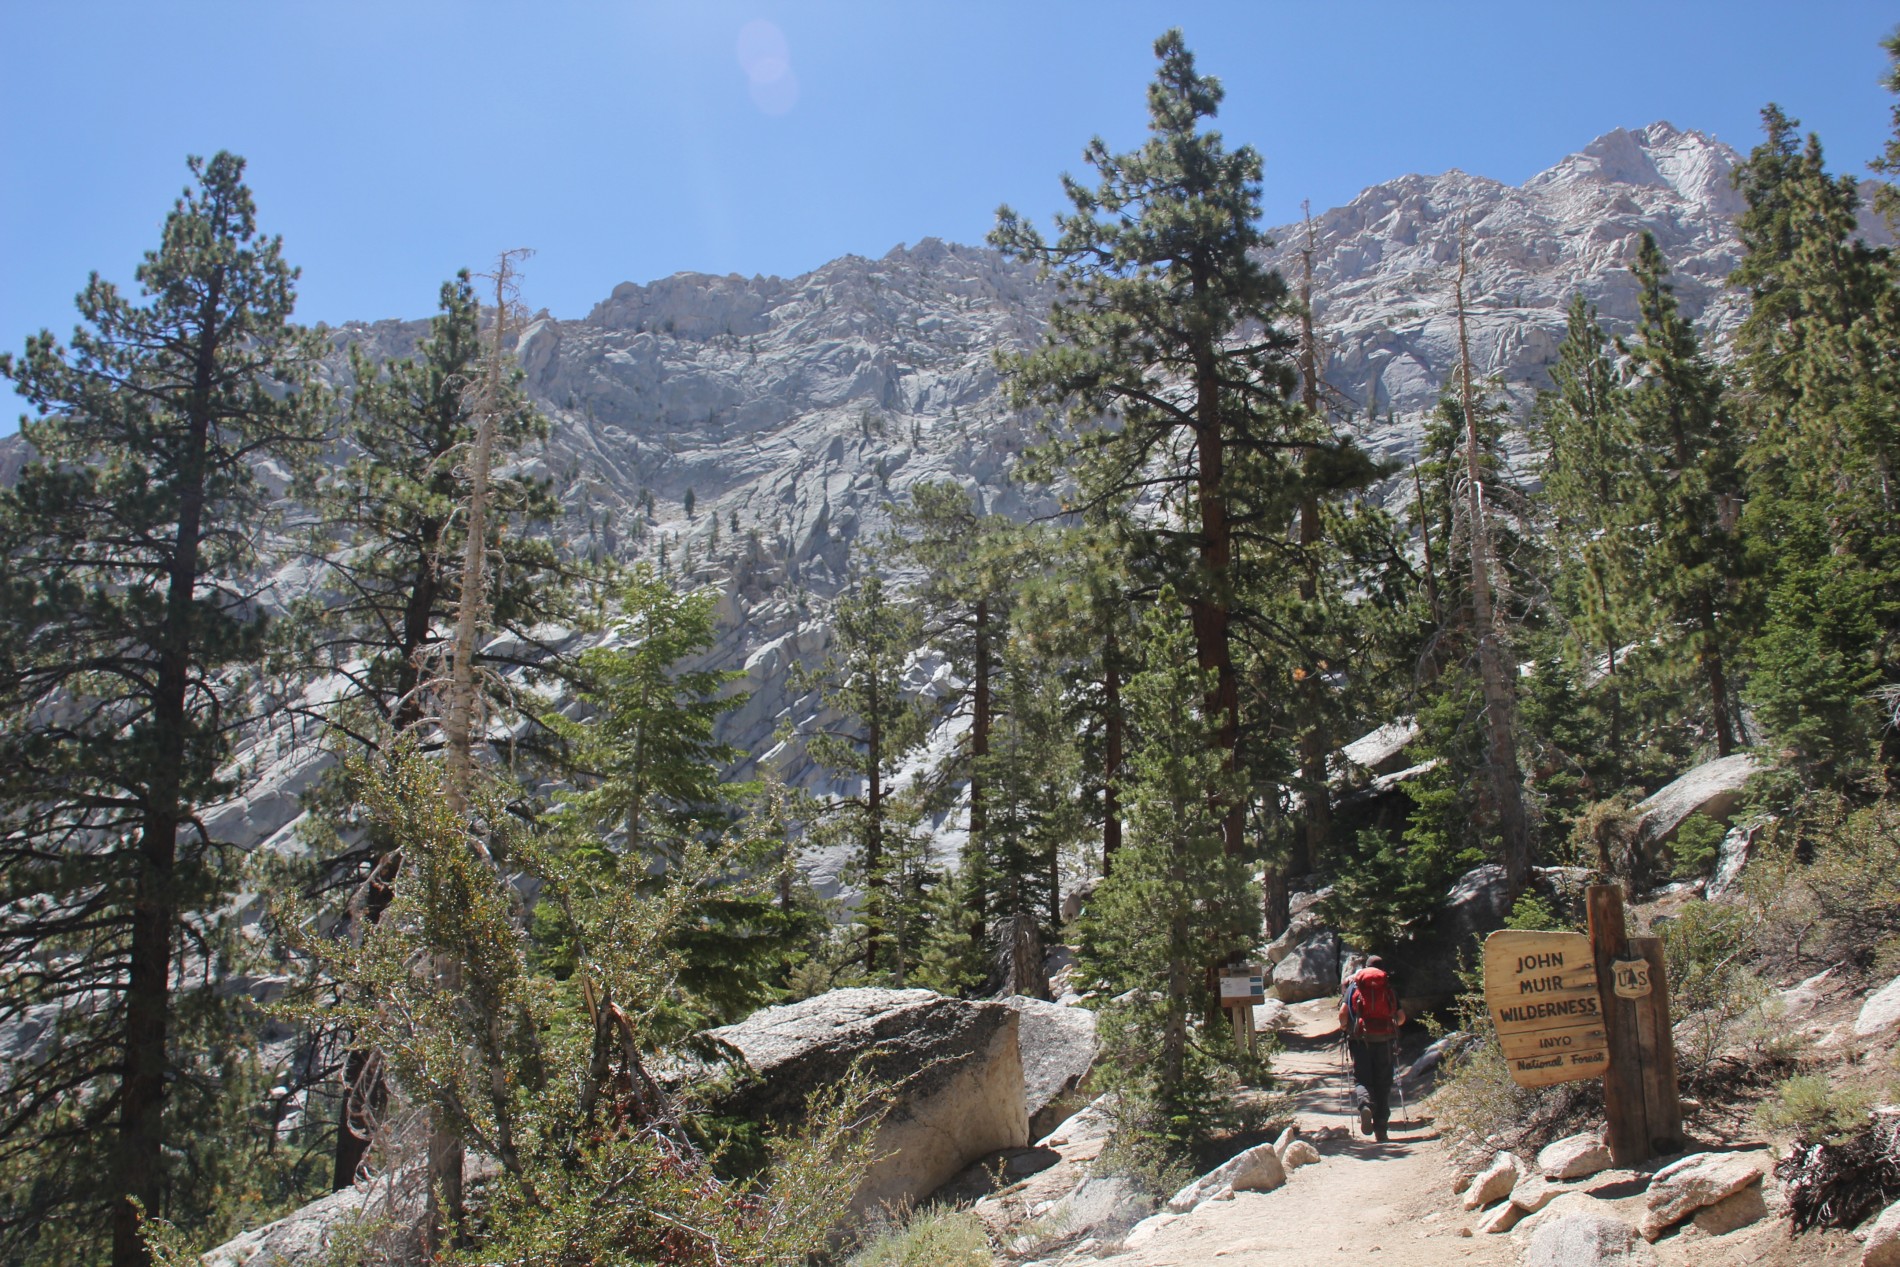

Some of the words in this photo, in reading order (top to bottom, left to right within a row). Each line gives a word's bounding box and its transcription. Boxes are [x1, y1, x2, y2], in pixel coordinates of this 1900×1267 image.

[1516, 952, 1563, 973] JOHN
[1520, 975, 1563, 994] MUIR
[1500, 998, 1597, 1022] WILDERNESS
[1539, 1036, 1571, 1048] INYO
[1517, 1056, 1563, 1071] National
[1570, 1053, 1604, 1065] Forest
